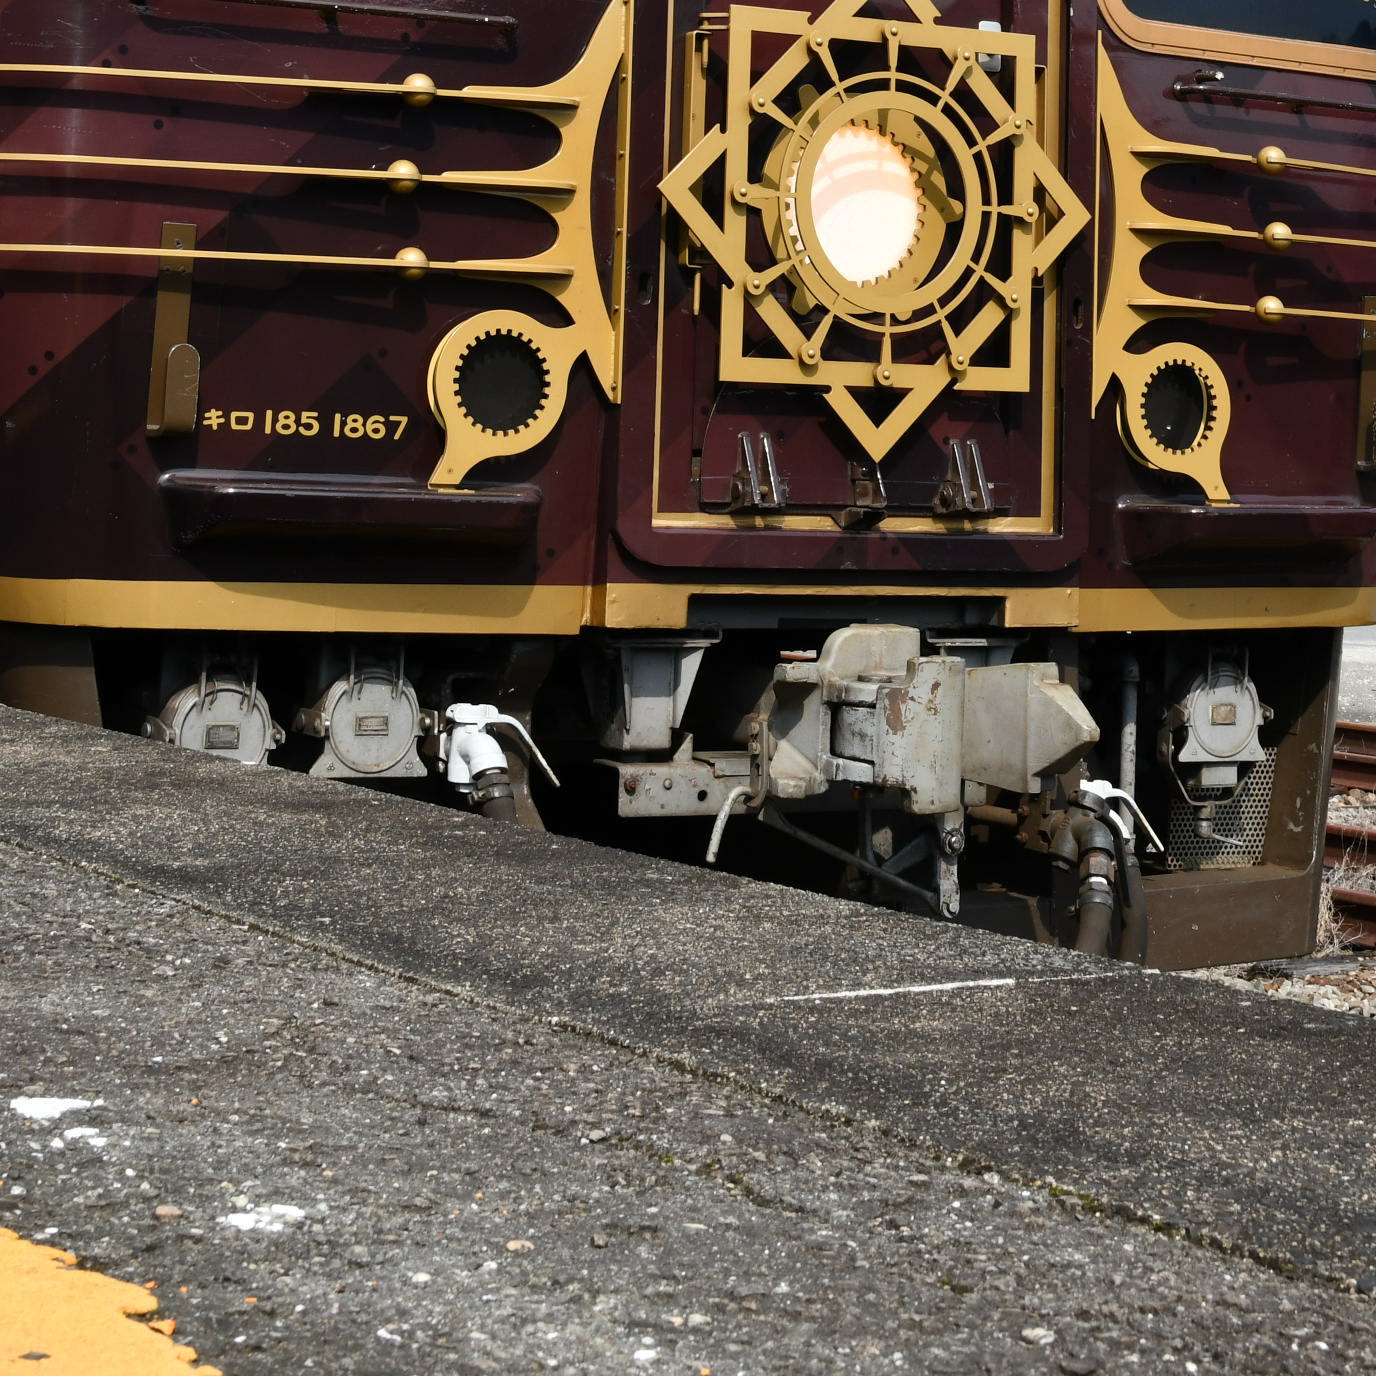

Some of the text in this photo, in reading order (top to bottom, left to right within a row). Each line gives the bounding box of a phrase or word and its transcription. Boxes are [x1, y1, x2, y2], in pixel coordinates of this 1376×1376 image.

[202, 408, 409, 440] キロ 185 1867
